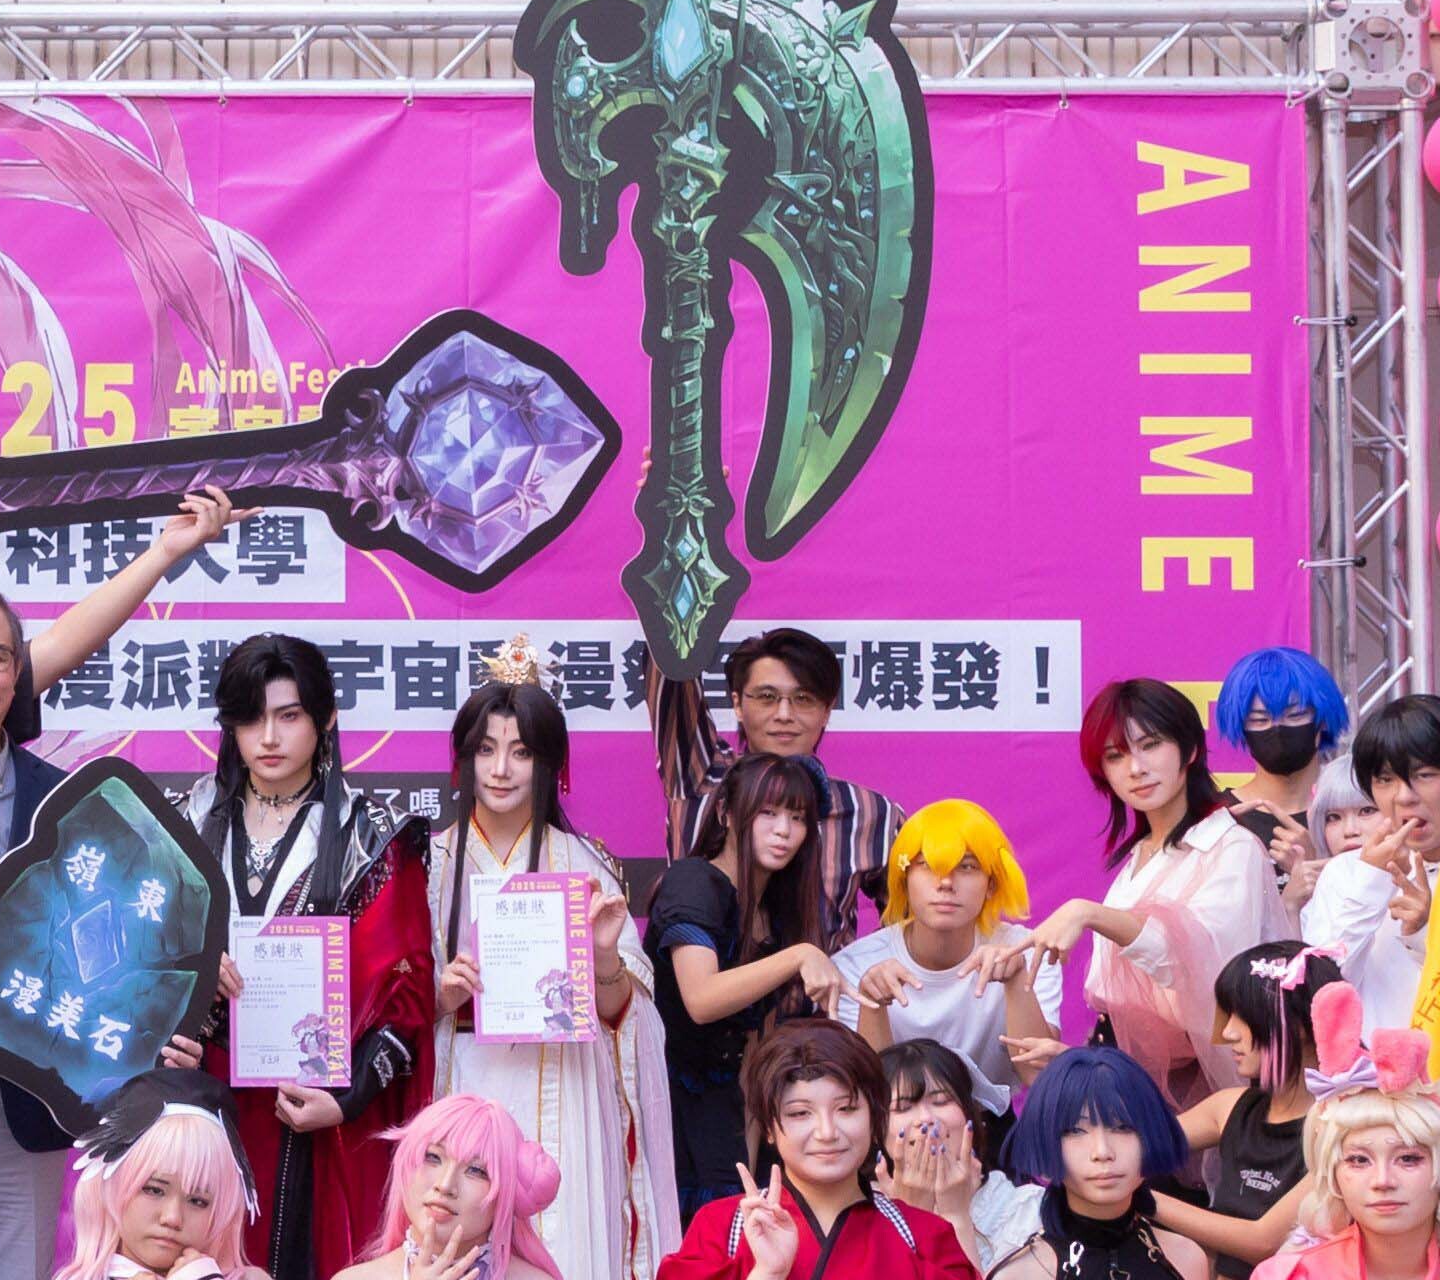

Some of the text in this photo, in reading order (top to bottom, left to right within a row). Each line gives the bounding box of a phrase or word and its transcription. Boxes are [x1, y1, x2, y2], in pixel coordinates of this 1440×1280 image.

[175, 361, 278, 394] Anime
[1136, 139, 1256, 593] ANIME
[568, 877, 588, 939] ANIME
[327, 922, 344, 984] ANIME
[0, 968, 132, 1061] 漫美石
